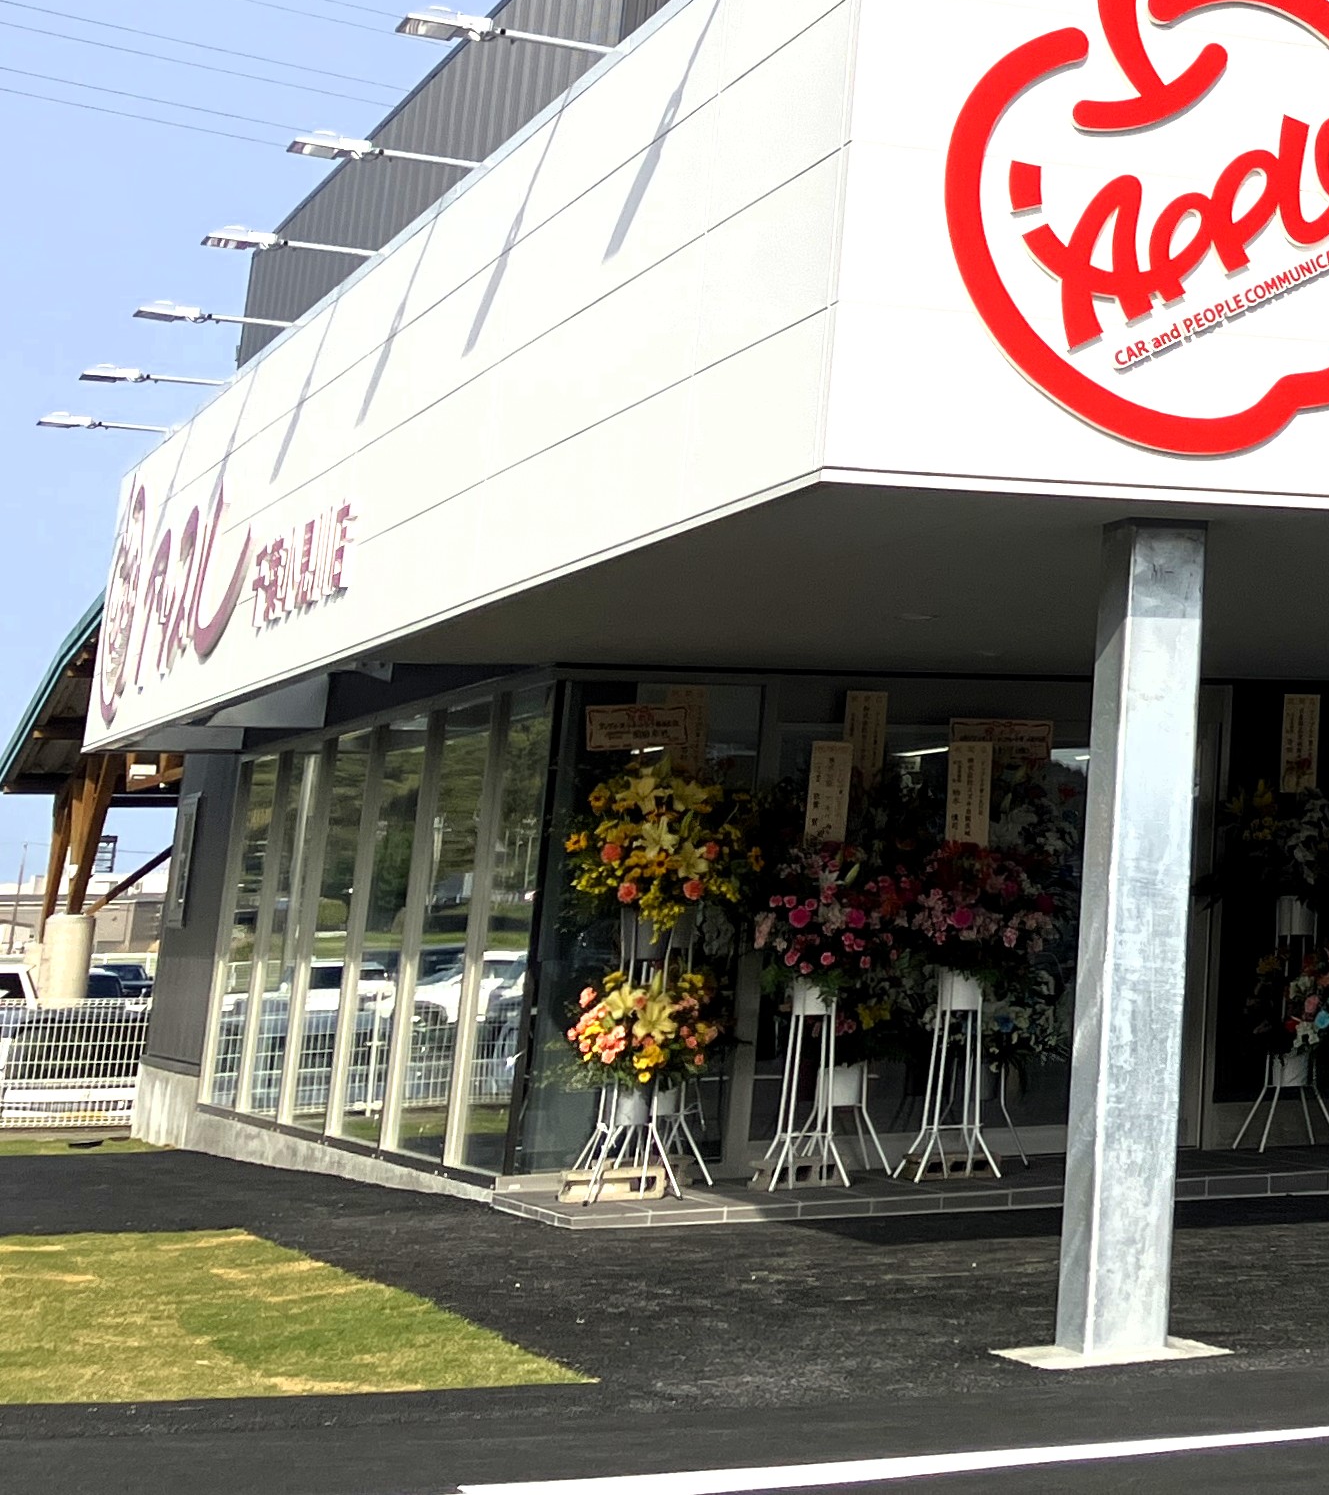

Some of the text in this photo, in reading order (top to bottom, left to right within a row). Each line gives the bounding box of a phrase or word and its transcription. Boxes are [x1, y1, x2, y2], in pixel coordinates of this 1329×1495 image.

[1114, 339, 1150, 366] CAR
[1152, 323, 1182, 349] and
[1184, 294, 1245, 334] PEOPLE
